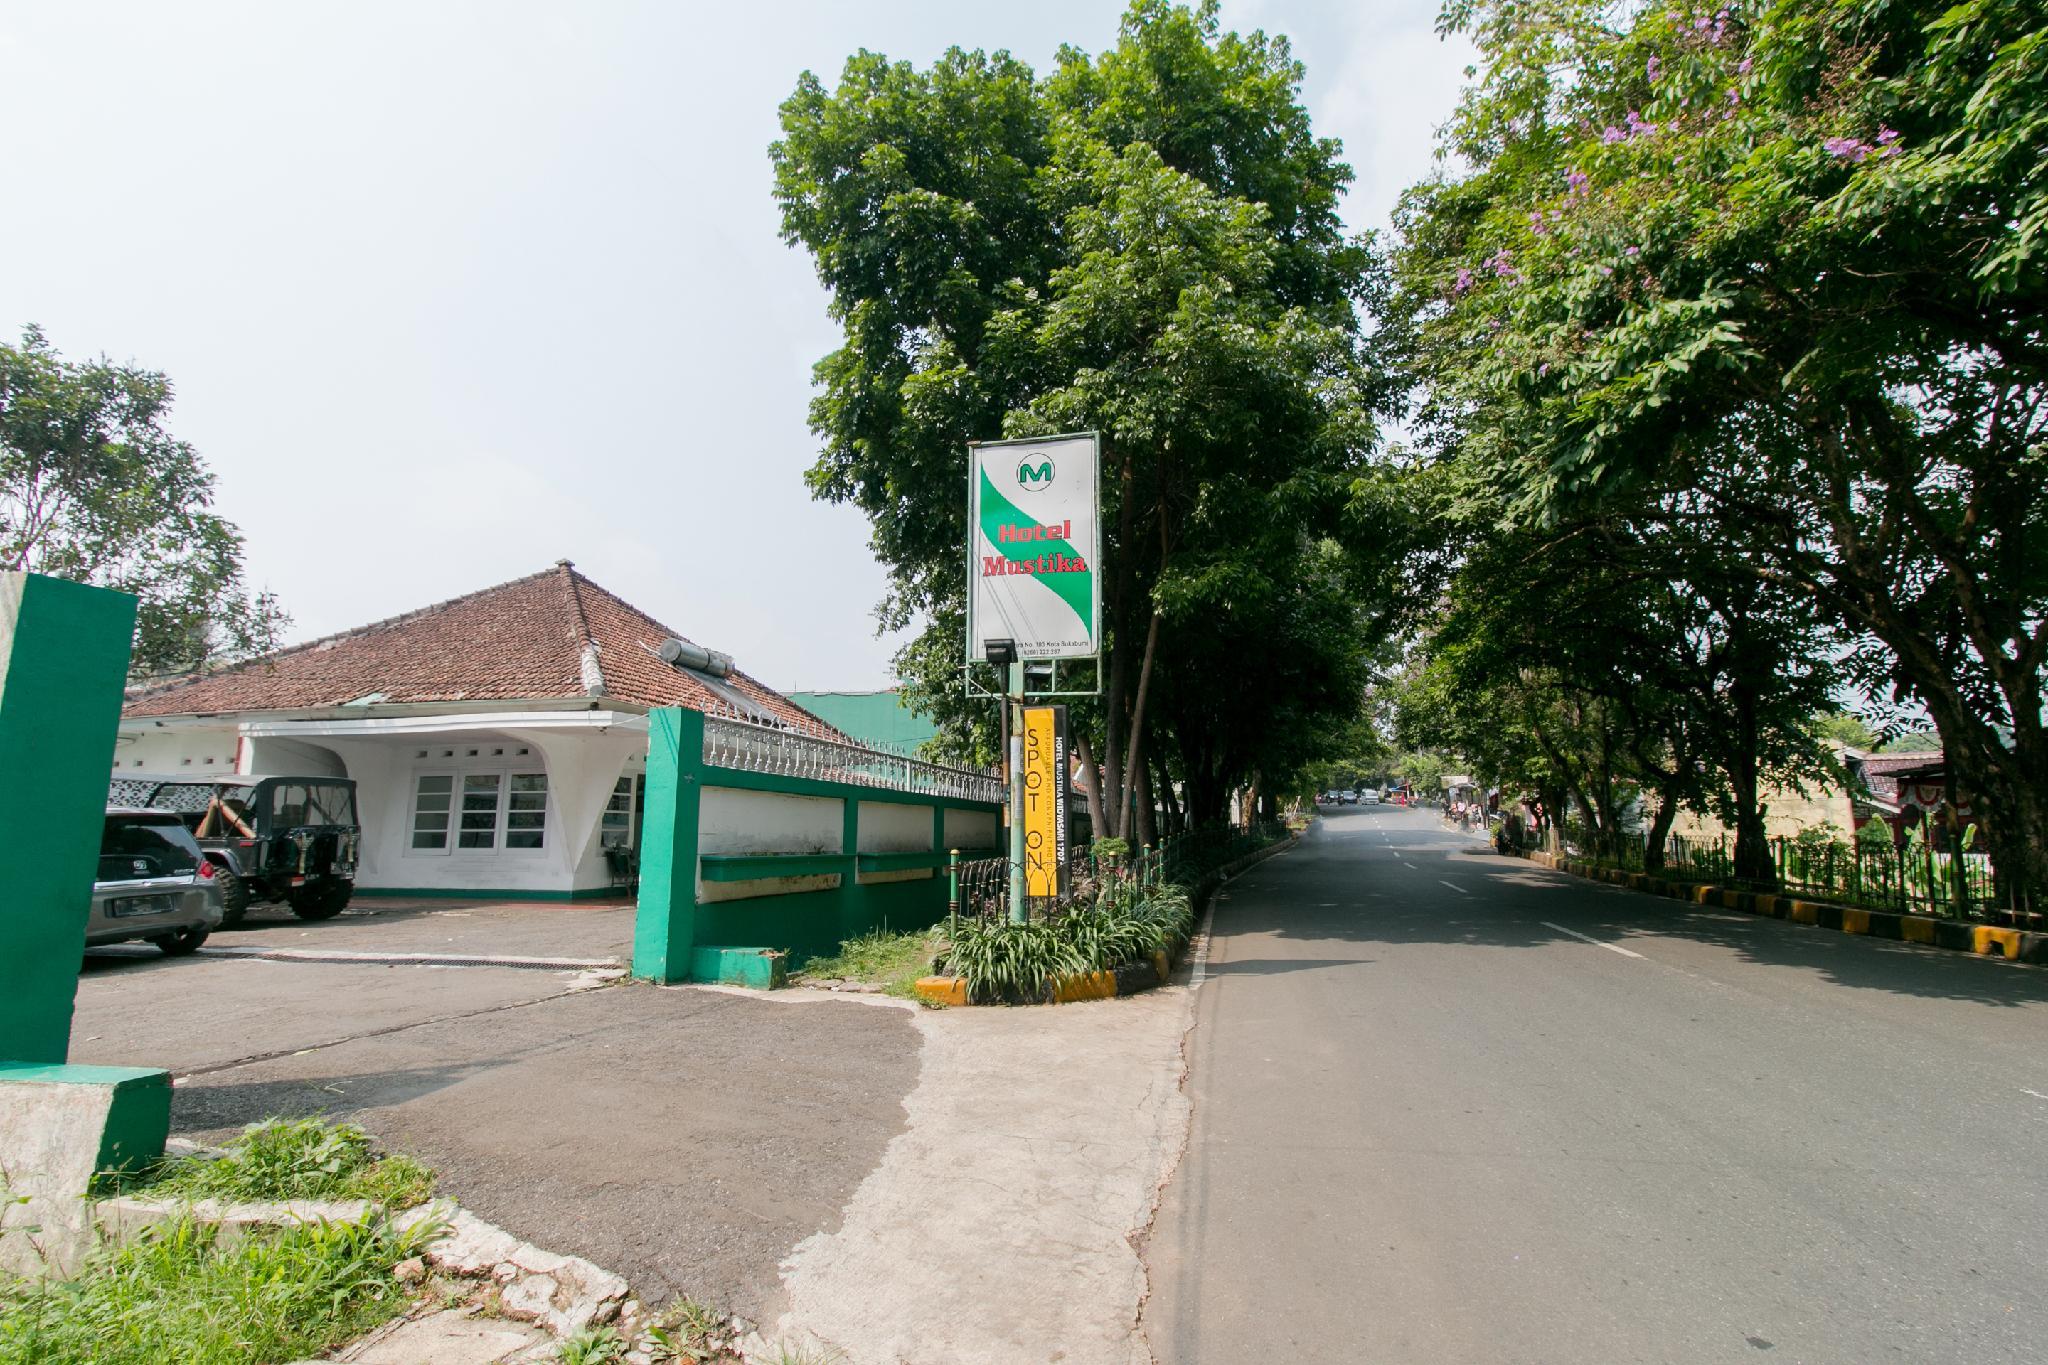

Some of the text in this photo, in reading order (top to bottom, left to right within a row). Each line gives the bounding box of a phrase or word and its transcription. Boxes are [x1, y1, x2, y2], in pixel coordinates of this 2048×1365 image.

[1020, 462, 1052, 483] M
[998, 520, 1071, 543] Hotel
[982, 551, 1089, 577] Mustika
[1056, 762, 1064, 798] MUSTIKA
[1026, 728, 1043, 871] SPOT ON
[1056, 797, 1065, 841] WIDYASARI
